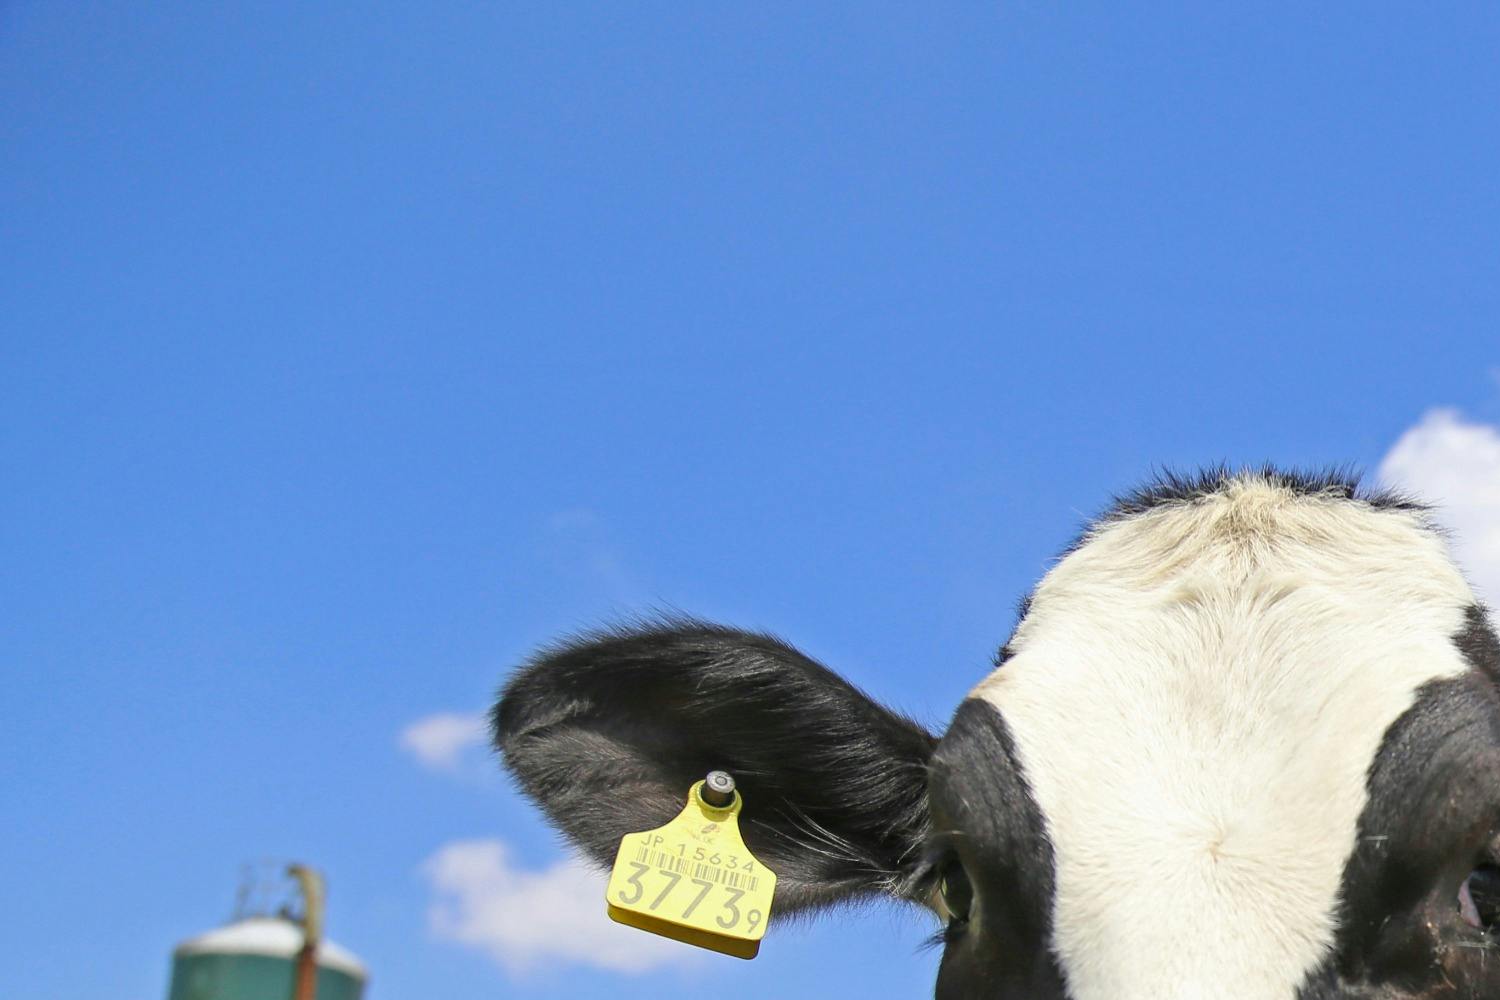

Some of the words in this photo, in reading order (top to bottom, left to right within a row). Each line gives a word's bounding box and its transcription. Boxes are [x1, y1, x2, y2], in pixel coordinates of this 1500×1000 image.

[641, 834, 664, 847] JP
[677, 844, 755, 873] 15634
[618, 861, 762, 933] 37739
